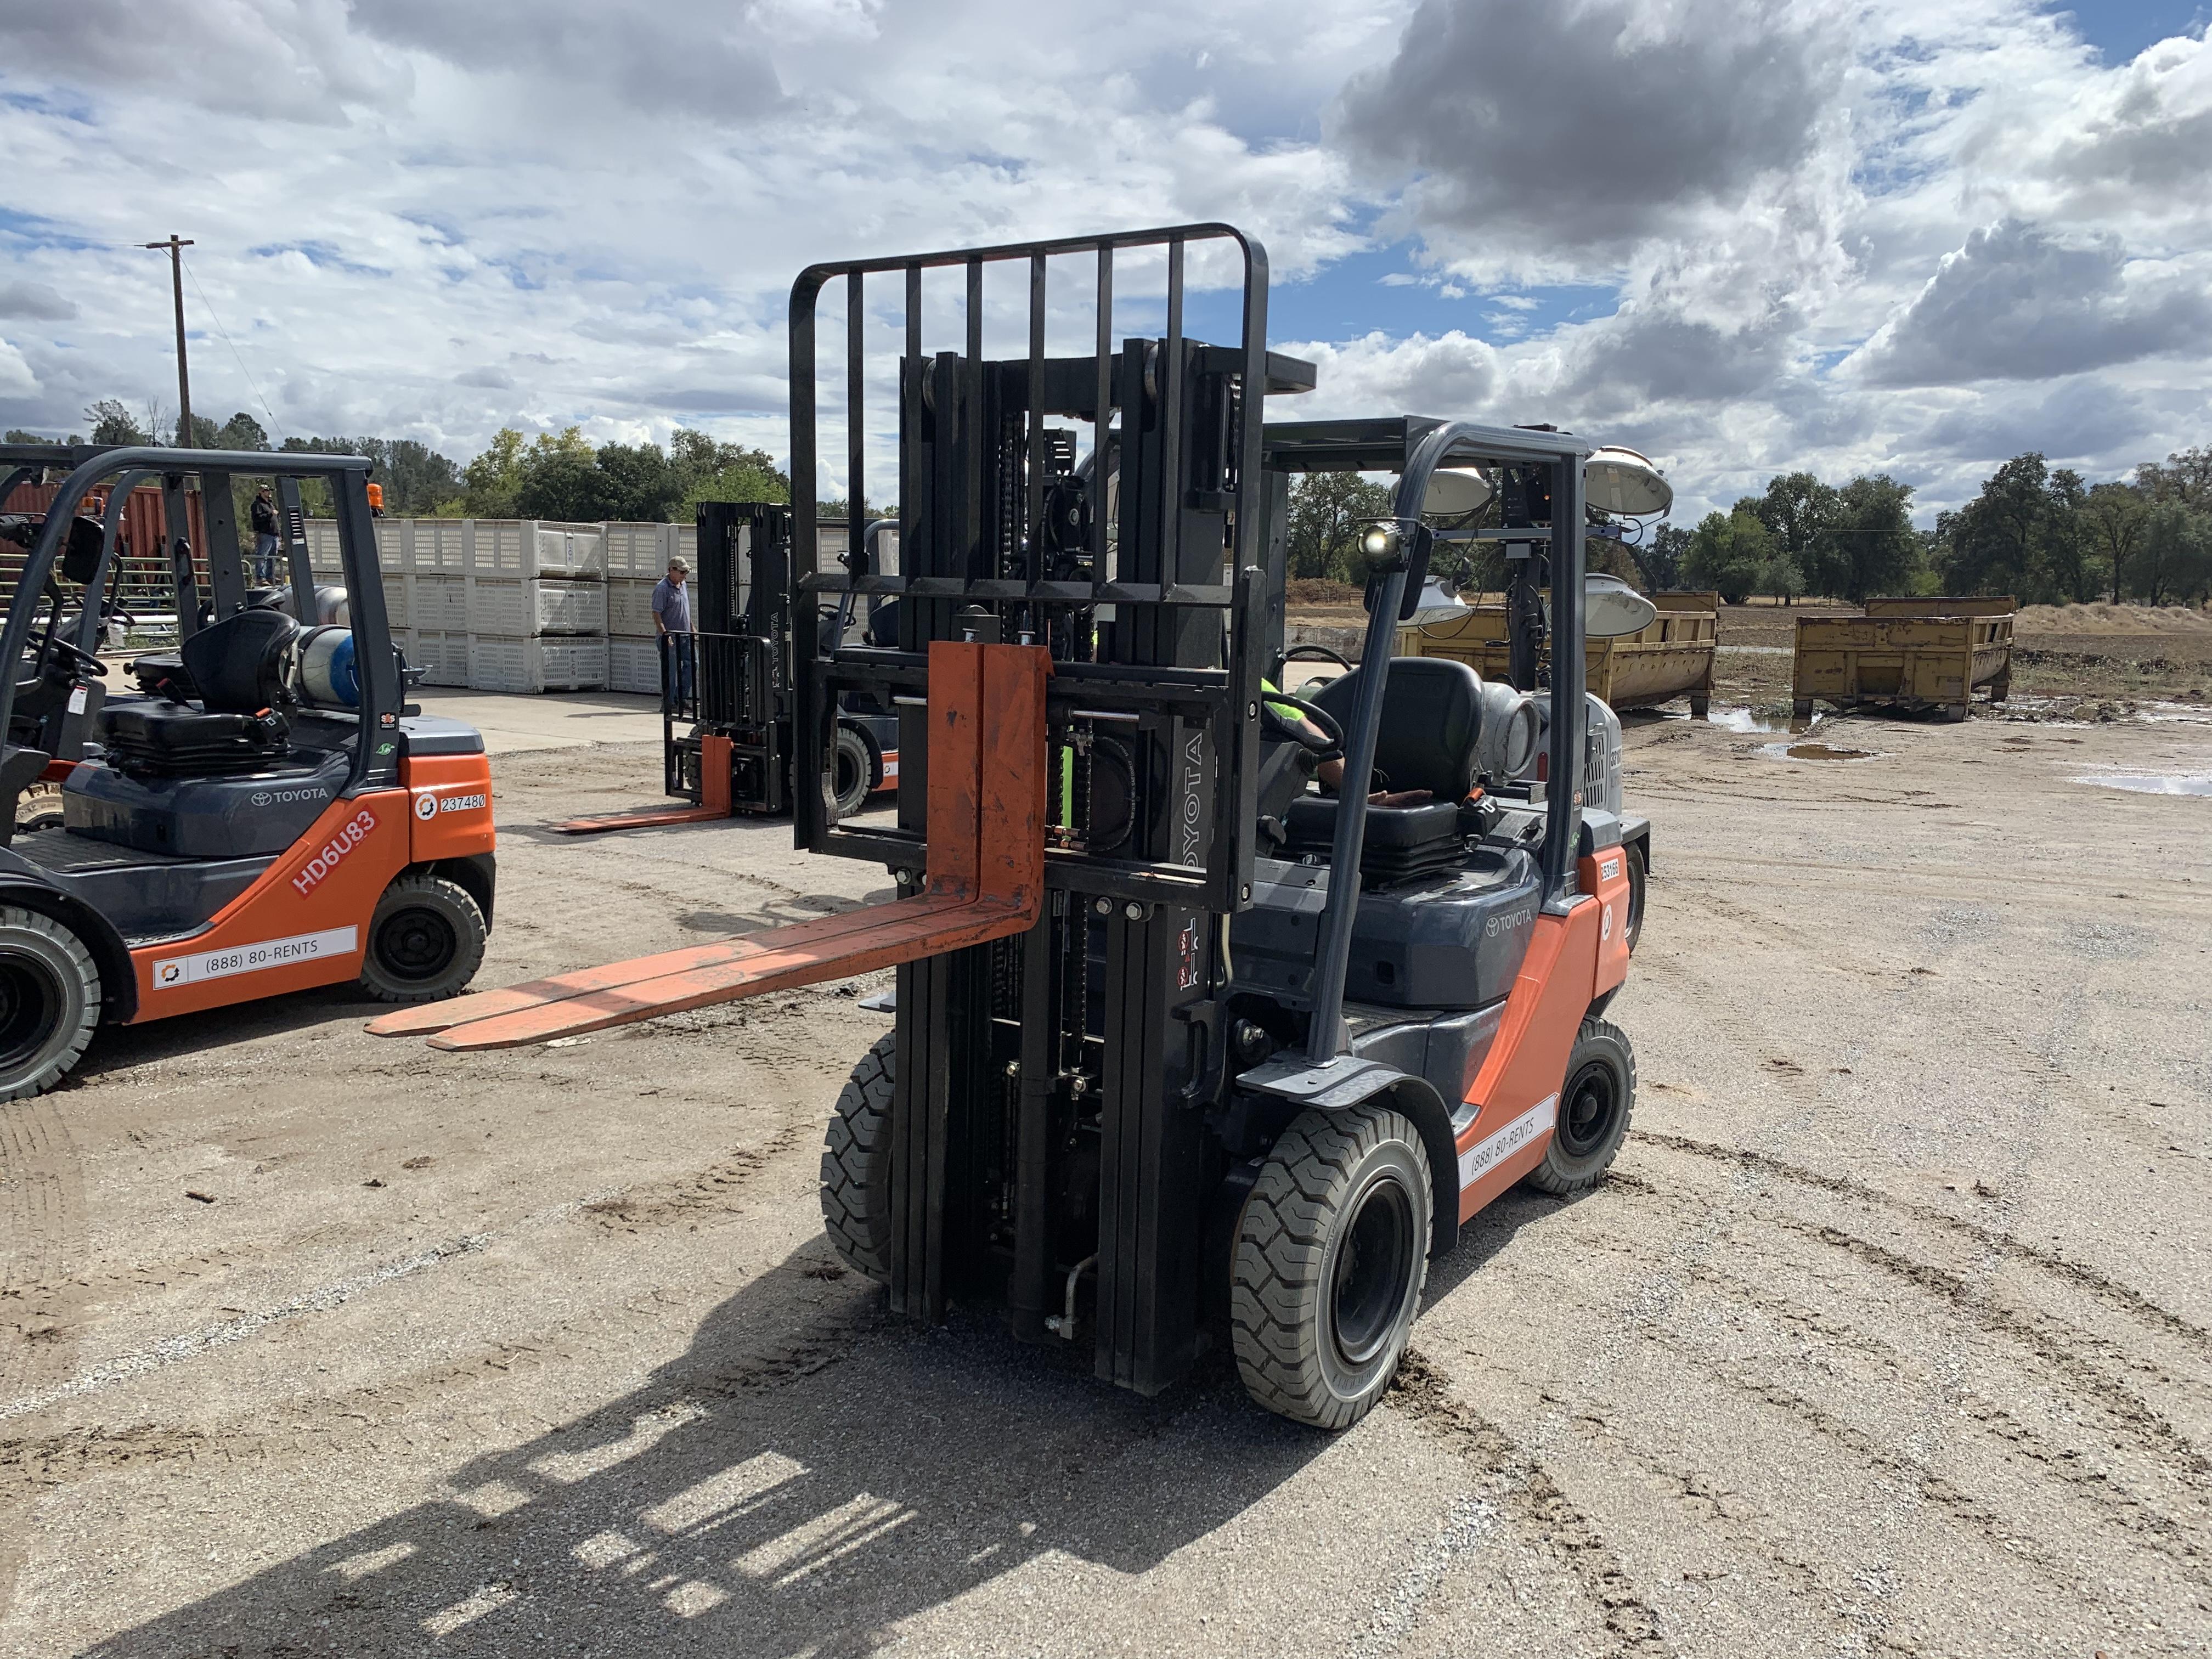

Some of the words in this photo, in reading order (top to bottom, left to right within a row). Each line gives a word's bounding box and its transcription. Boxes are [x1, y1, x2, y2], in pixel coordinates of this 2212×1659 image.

[273, 787, 329, 803] TOYOTA
[442, 794, 485, 811] 237480
[1183, 733, 1202, 868] OYOTA
[292, 811, 375, 894] HD6U83
[1499, 909, 1532, 931] TOYOTA
[206, 954, 242, 973] (888)
[249, 940, 318, 964] 80-RENTS
[1472, 1144, 1493, 1175] (888)
[1495, 1117, 1534, 1156] 80-RENTS
